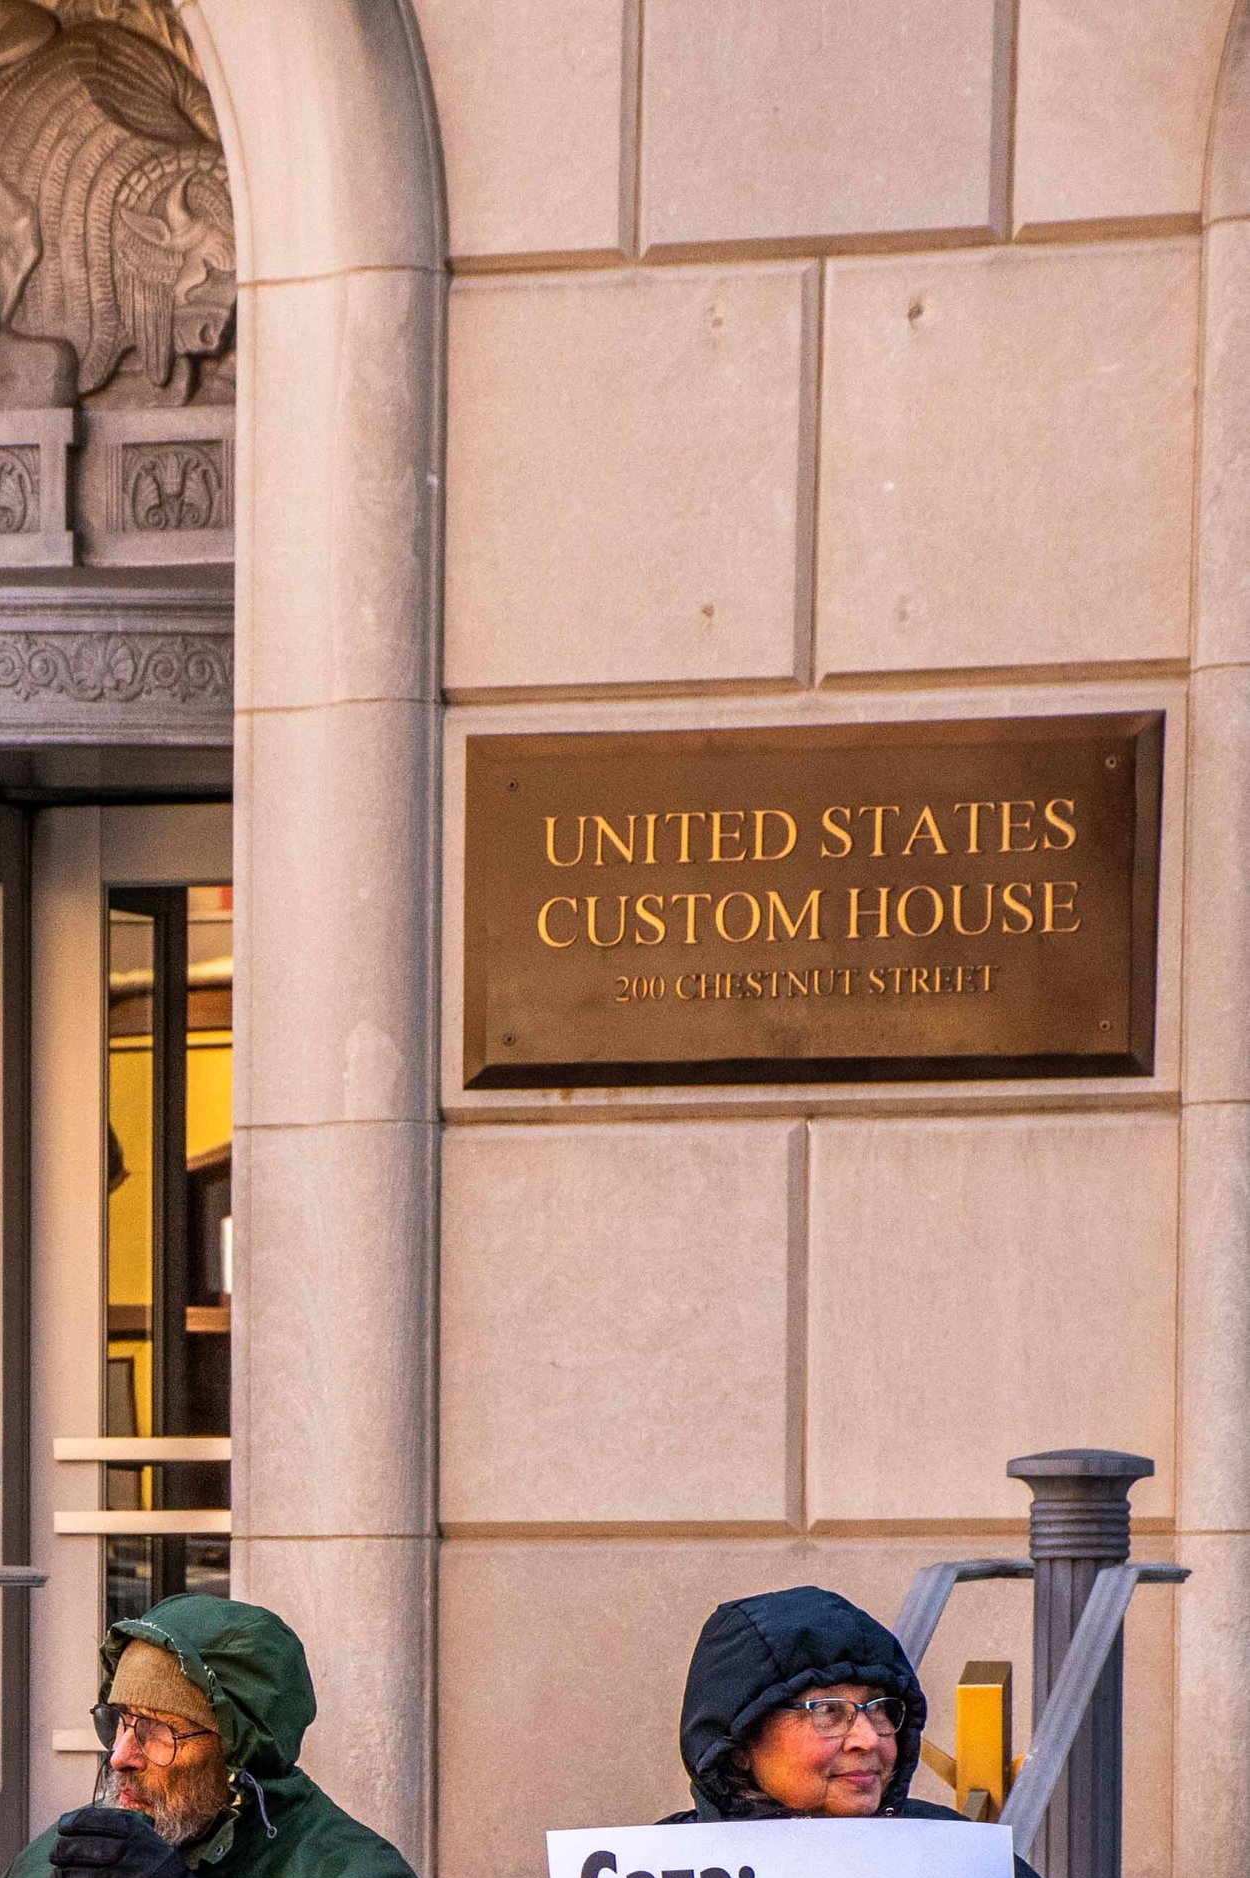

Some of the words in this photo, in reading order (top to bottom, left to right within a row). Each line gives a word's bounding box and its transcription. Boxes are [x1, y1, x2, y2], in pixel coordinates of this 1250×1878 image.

[545, 808, 798, 867] UNITED
[820, 798, 1078, 859] STATES
[537, 888, 823, 948] CUSTOM
[847, 880, 1082, 939] HOUSE
[615, 973, 667, 1002] 200
[675, 966, 860, 1000] CHESTNUT
[868, 965, 999, 994] STREET
